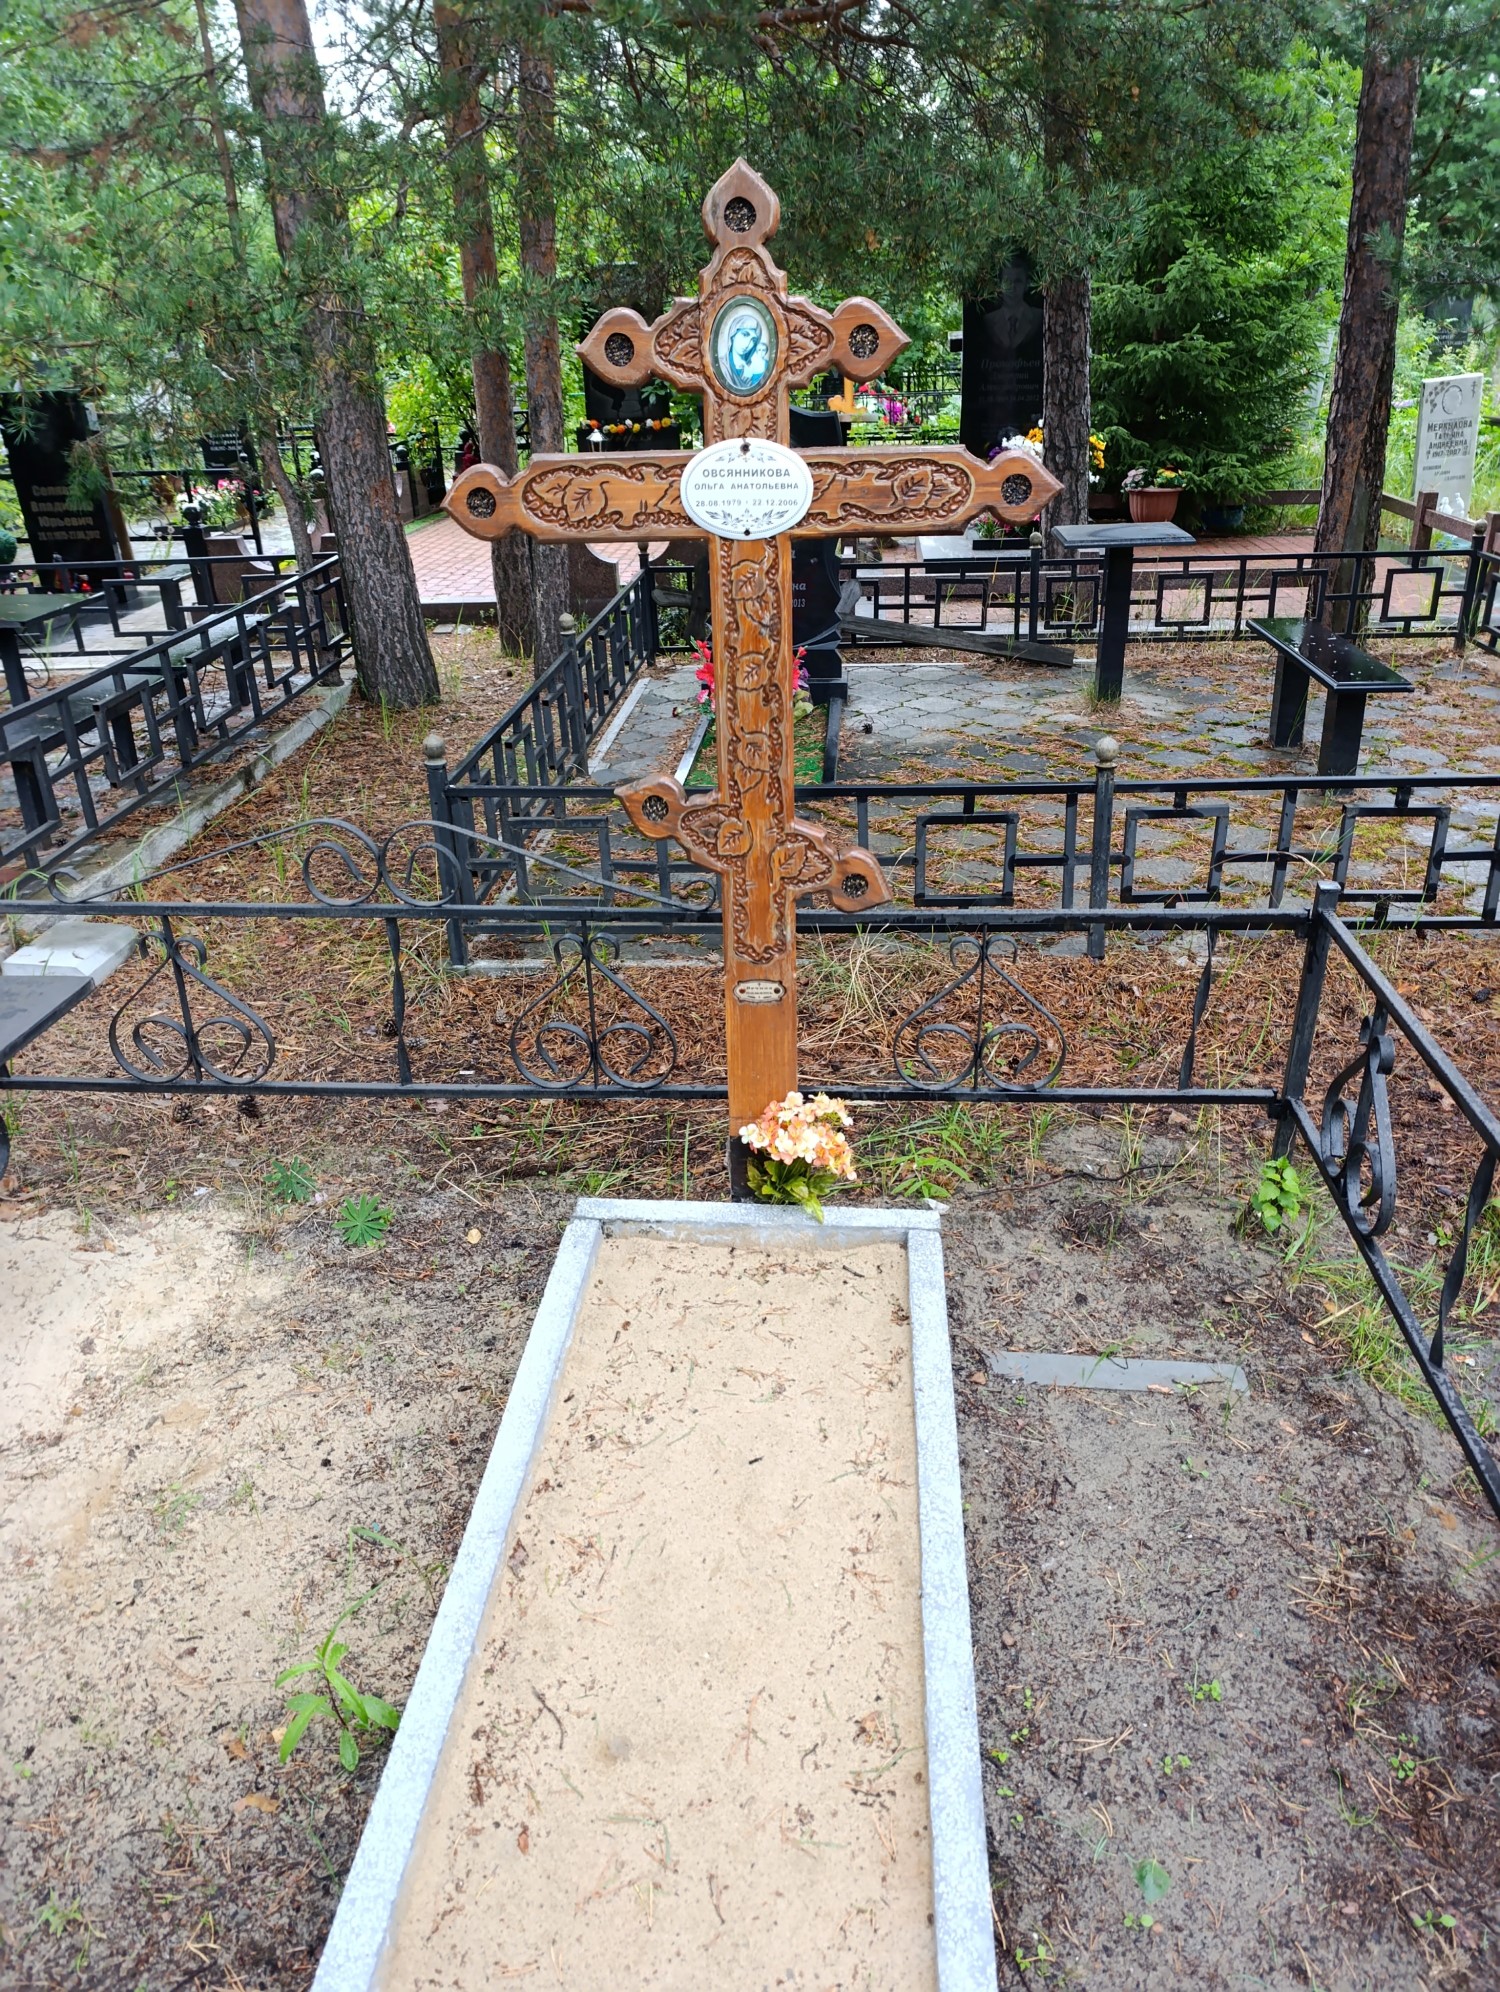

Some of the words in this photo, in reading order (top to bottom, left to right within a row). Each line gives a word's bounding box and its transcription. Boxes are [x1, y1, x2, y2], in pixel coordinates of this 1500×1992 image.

[702, 468, 790, 478] ОВСЯННИКОВА
[694, 482, 725, 491] ОЛЬГА
[730, 482, 799, 491] АНАТОЛЬЕВНА
[696, 499, 742, 508] 28.08.1979
[752, 499, 798, 507] 22.12.2006
[38, 516, 94, 527] Юрьевич
[792, 582, 806, 591] на
[792, 598, 806, 608] 013
